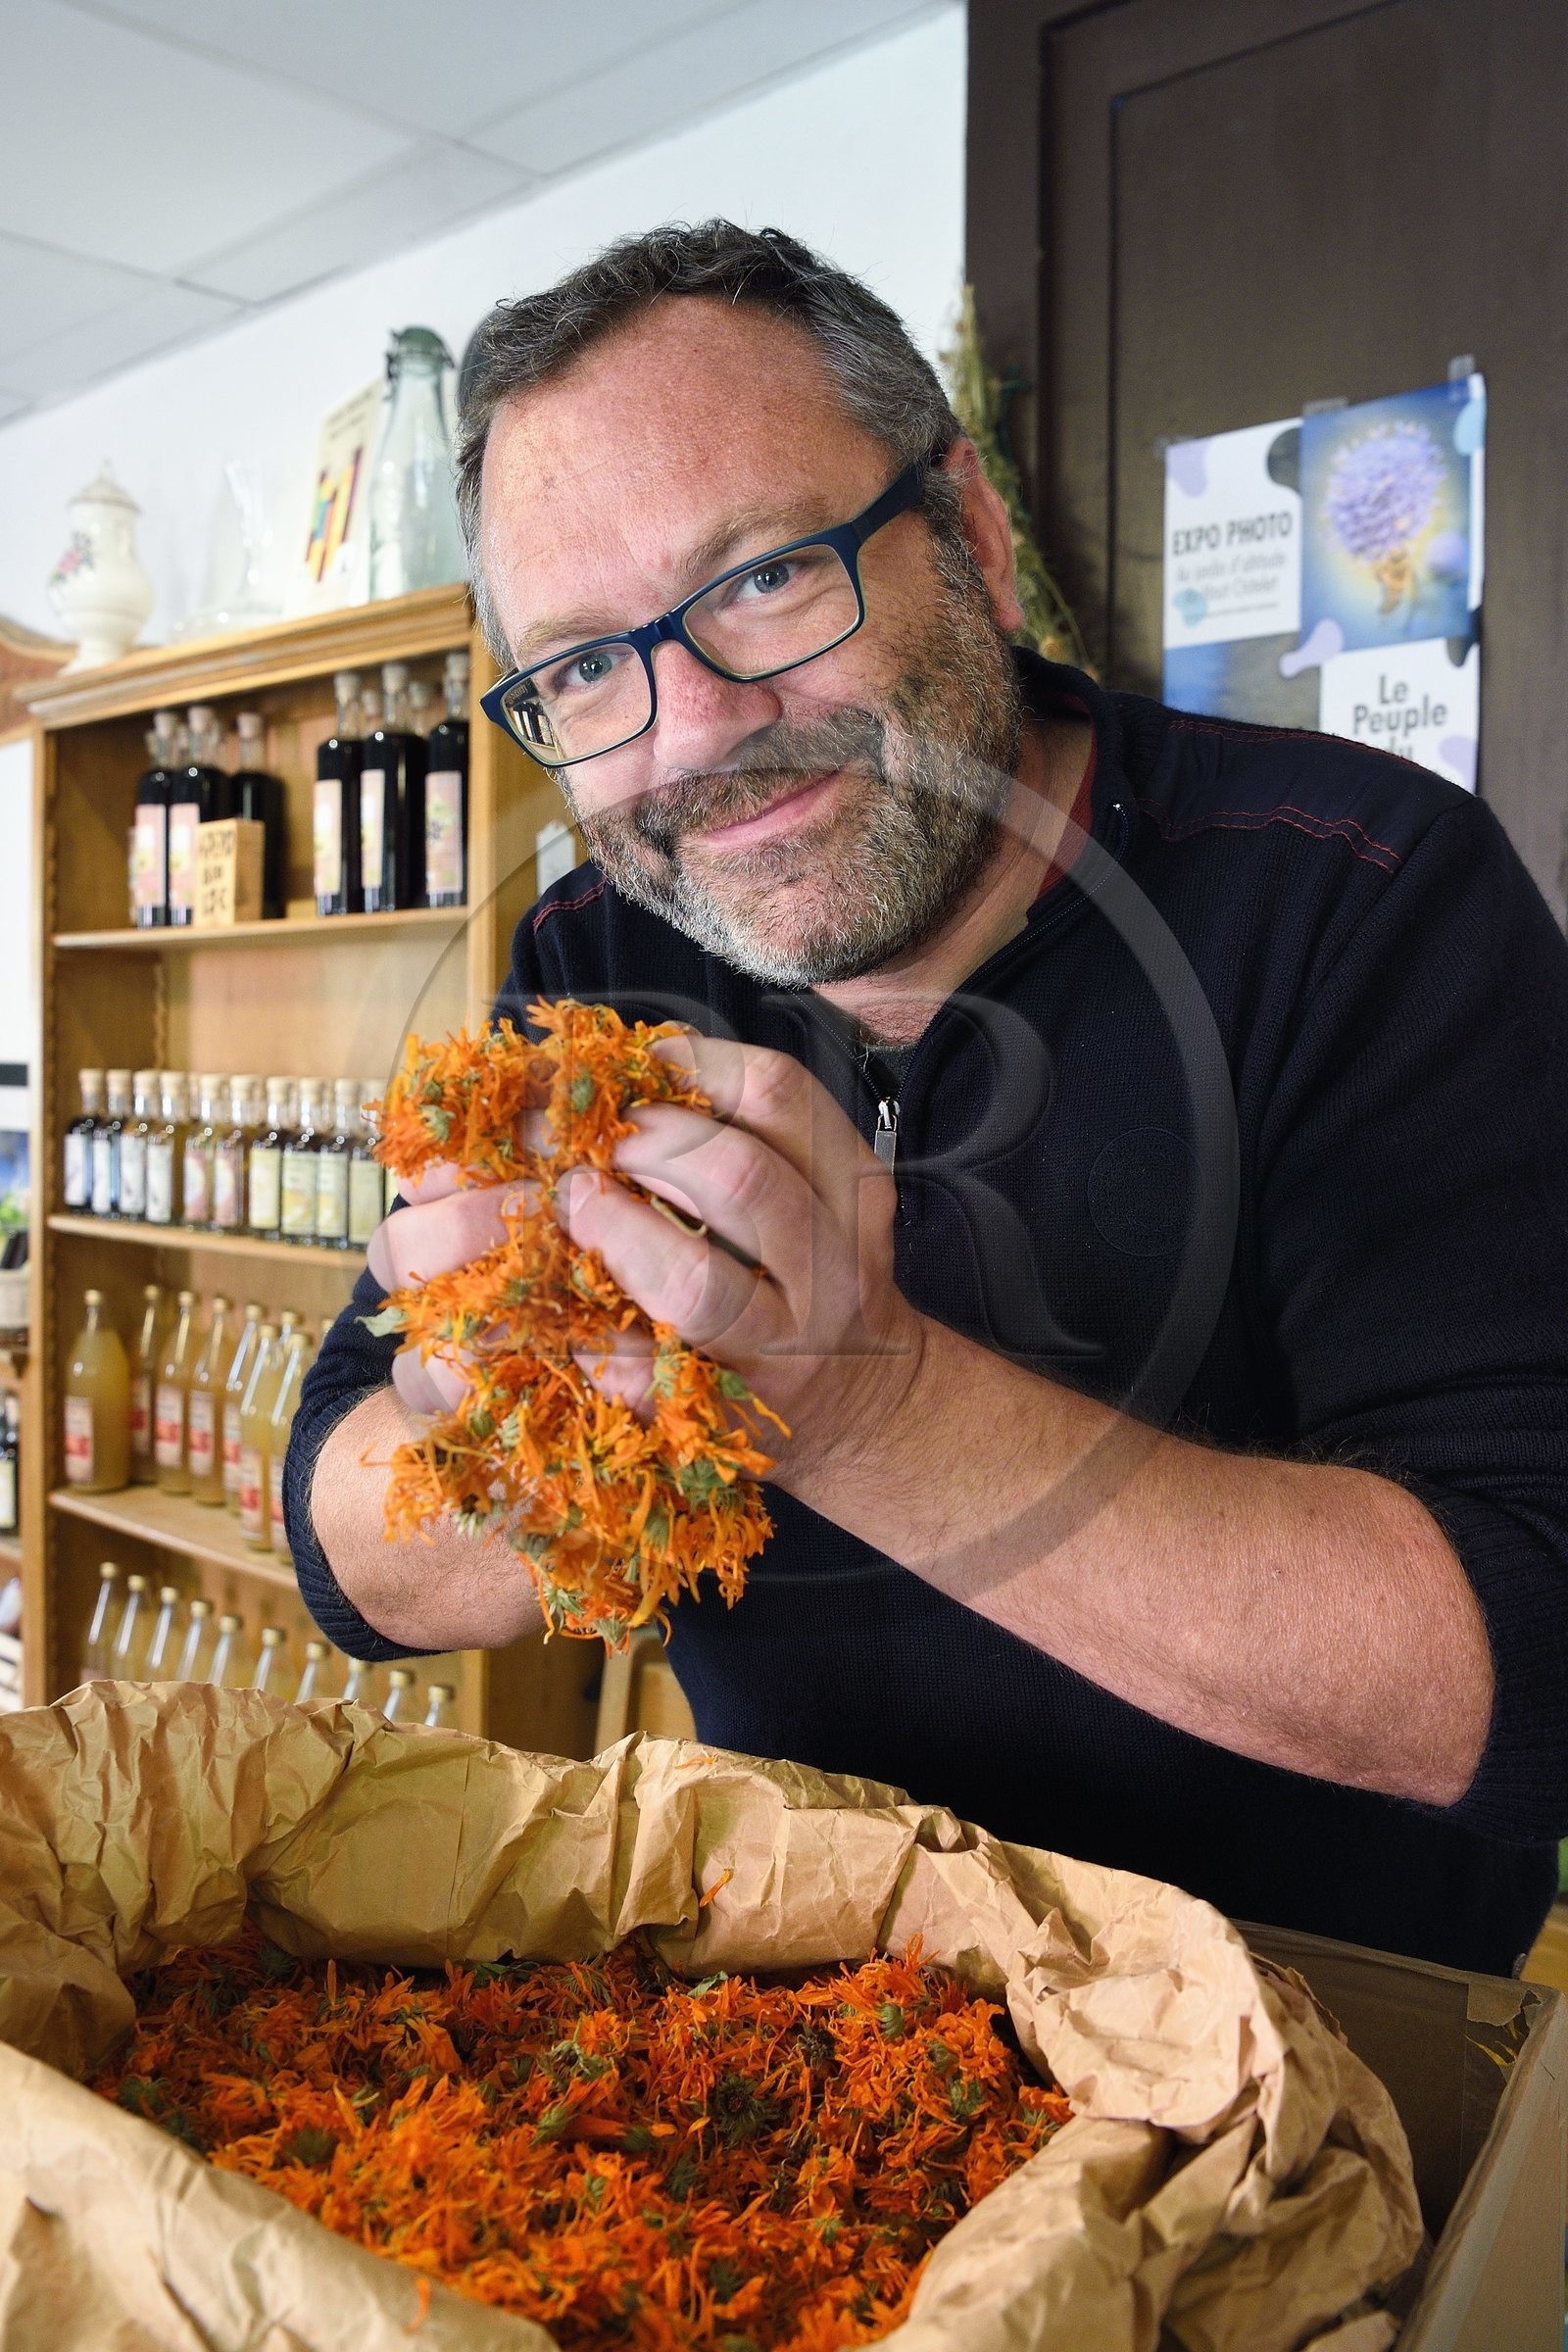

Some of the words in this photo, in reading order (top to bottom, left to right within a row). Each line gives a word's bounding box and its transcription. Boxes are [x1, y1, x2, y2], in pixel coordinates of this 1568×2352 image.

[1172, 521, 1221, 557] EXPO
[1226, 511, 1293, 547] PHOTO
[1380, 672, 1408, 705] Le
[1352, 694, 1447, 737] Peuple
